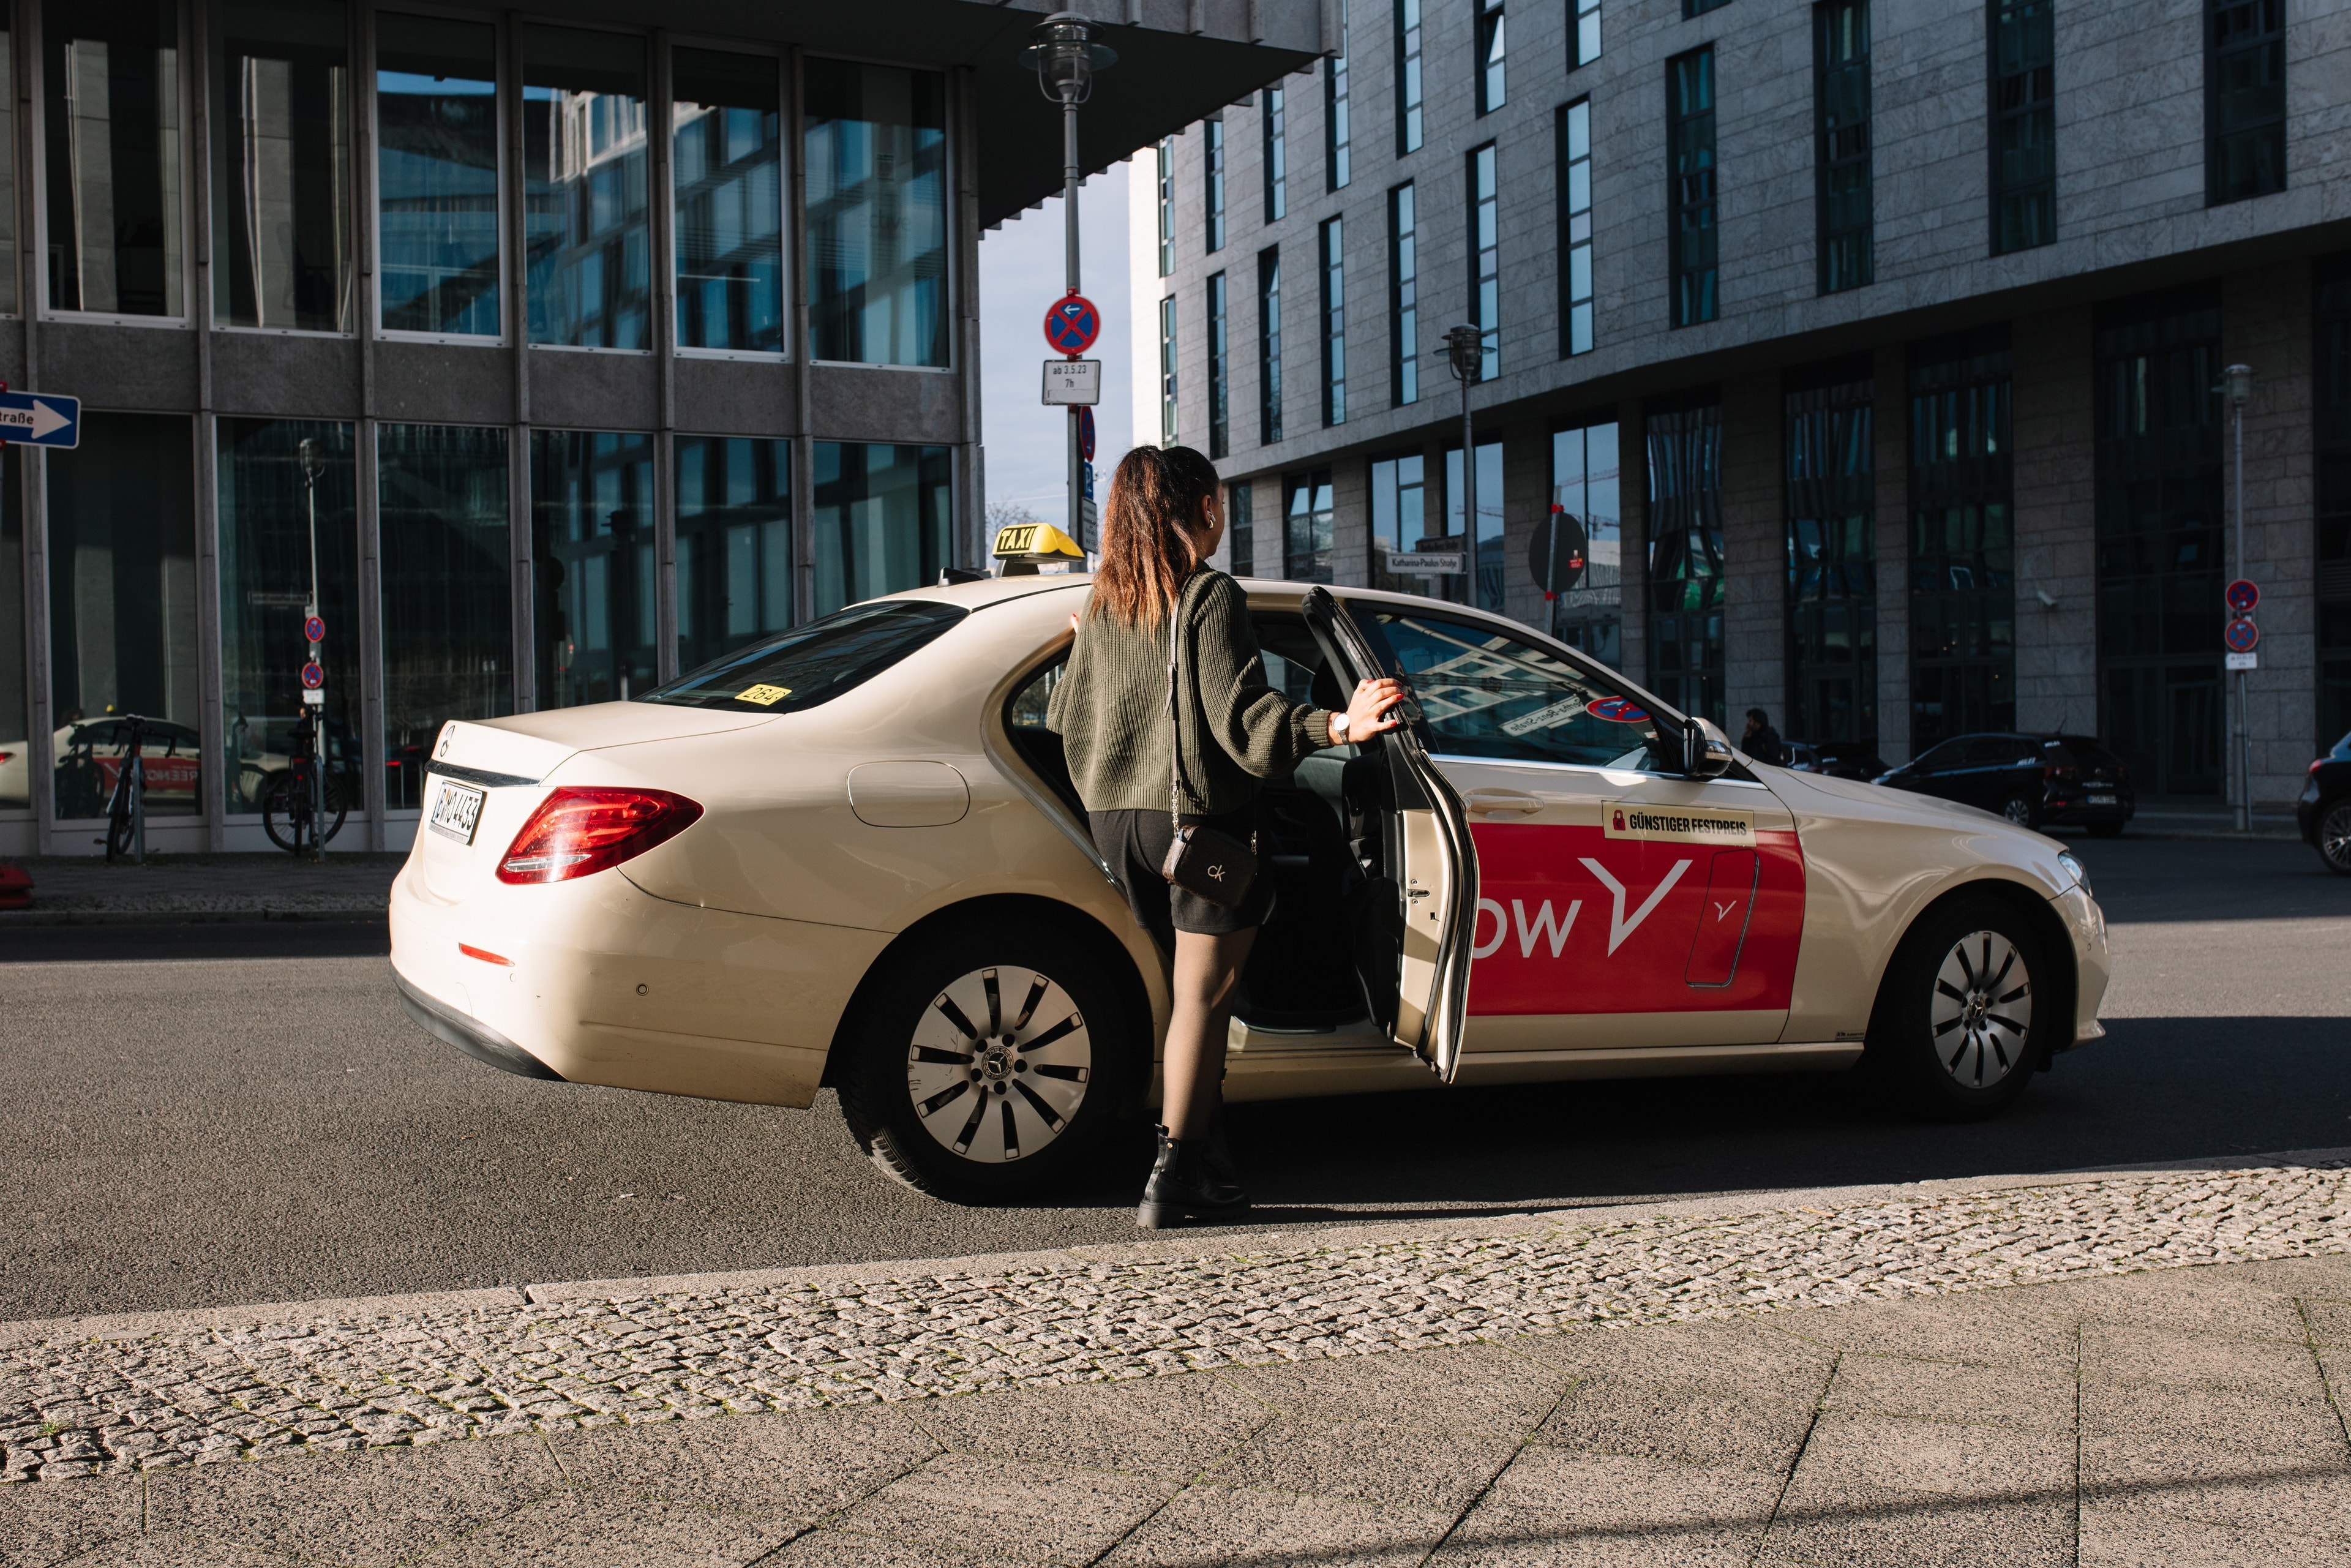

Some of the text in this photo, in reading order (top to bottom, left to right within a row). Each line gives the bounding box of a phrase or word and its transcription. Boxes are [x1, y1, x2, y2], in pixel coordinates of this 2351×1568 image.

[1053, 364, 1087, 375] ab 3.5.23
[1065, 378, 1074, 388] 7h
[1000, 528, 1035, 549] TAXI
[453, 794, 479, 831] 4433
[1630, 811, 1747, 836] GÜNSTIGER FESTPREIS
